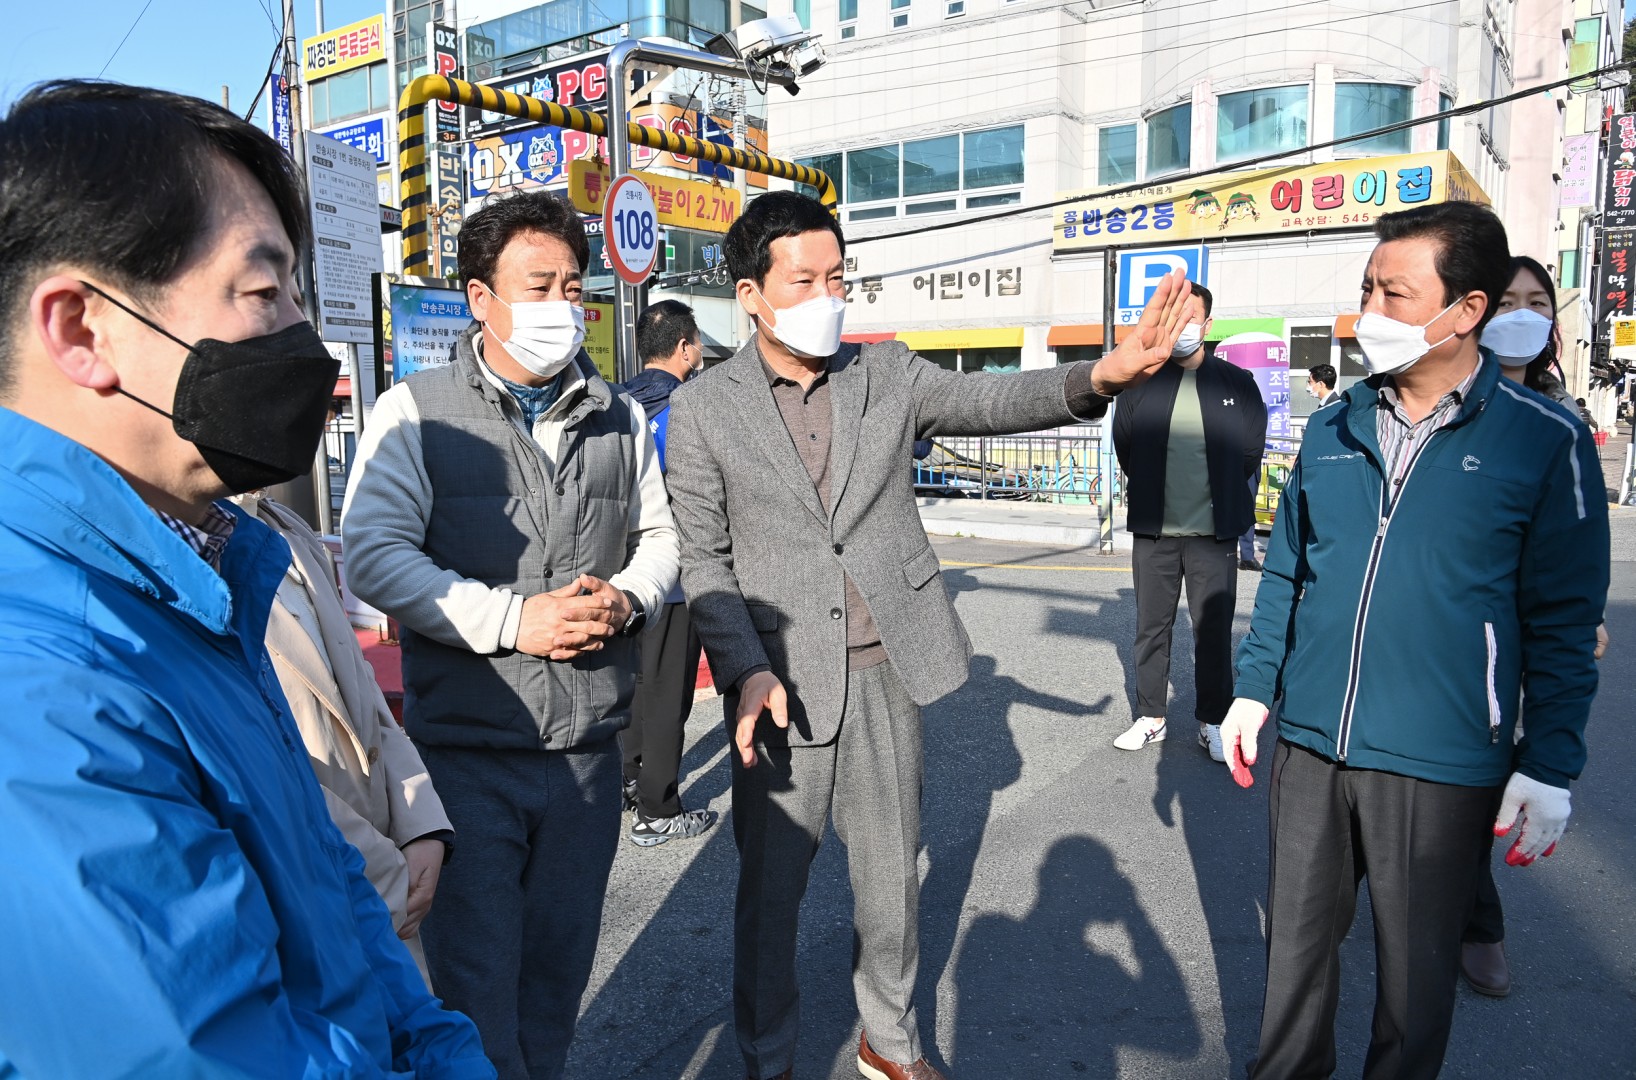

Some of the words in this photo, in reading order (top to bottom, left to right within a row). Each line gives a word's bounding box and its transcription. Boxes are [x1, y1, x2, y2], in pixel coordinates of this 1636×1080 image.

[307, 39, 337, 71] 짜장면
[339, 23, 380, 58] 무료급식
[435, 29, 456, 49] OX
[443, 132, 456, 141] 3F
[473, 141, 524, 191] OX
[529, 150, 557, 166] OXPC
[625, 189, 643, 201] 전통시장
[1271, 165, 1433, 213] 어린이집
[696, 194, 735, 224] 2.7M
[1082, 201, 1175, 236] 반송2동
[1607, 209, 1635, 217] 542-7770
[614, 208, 655, 250] 108
[913, 266, 1022, 300] 어린이집
[1128, 253, 1188, 306] P
[421, 302, 462, 316] 반송큰시장
[403, 327, 408, 335] 1.
[411, 327, 430, 337] 화단내
[403, 341, 410, 349] 2.
[412, 341, 436, 351] 주차선을
[404, 356, 410, 364] 3.
